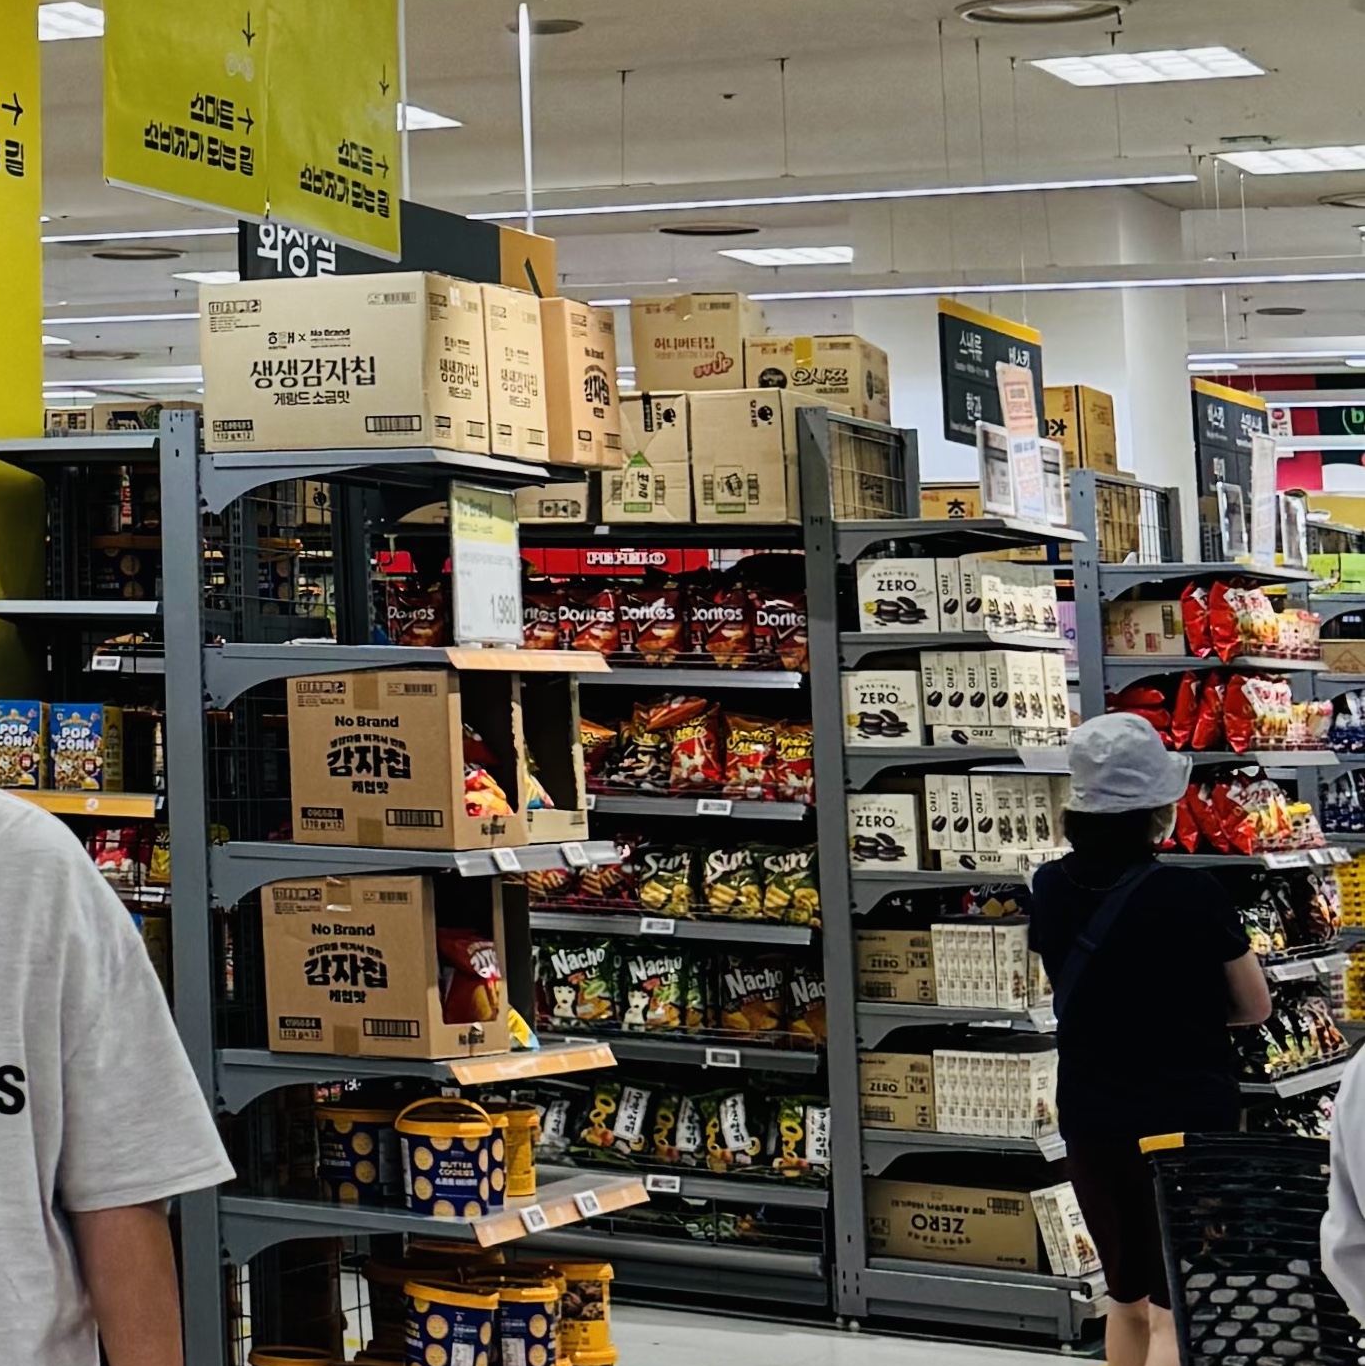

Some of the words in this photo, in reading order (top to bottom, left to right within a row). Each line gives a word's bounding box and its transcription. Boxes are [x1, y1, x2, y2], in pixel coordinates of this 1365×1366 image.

[190, 92, 234, 131] 스마트
[5, 139, 24, 177] 길
[144, 120, 204, 164] 소비자가
[240, 146, 254, 176] 길
[338, 138, 373, 176] 스마트
[250, 356, 376, 388] 생생감자칩
[313, 390, 350, 405] 소금맛
[877, 580, 916, 592] ZERO
[559, 606, 614, 623] Doritos
[621, 606, 674, 621] Doritos
[860, 693, 898, 704] ZERO
[0, 724, 29, 735] POP
[335, 715, 353, 728] No
[356, 715, 399, 728] Brand
[57, 739, 95, 750] CORN
[62, 728, 90, 739] POP
[327, 743, 411, 779] 감자칩
[856, 815, 896, 827] ZERO
[644, 851, 689, 877] Sun
[708, 847, 752, 880] Sun
[764, 852, 811, 875] Sun
[312, 924, 331, 936] No
[334, 924, 375, 936] Brand
[304, 953, 388, 989] 감자칩
[552, 948, 605, 978] Nacho
[629, 955, 682, 984] Nacho
[726, 969, 783, 998] Nacho
[912, 1213, 965, 1234] ZERO
